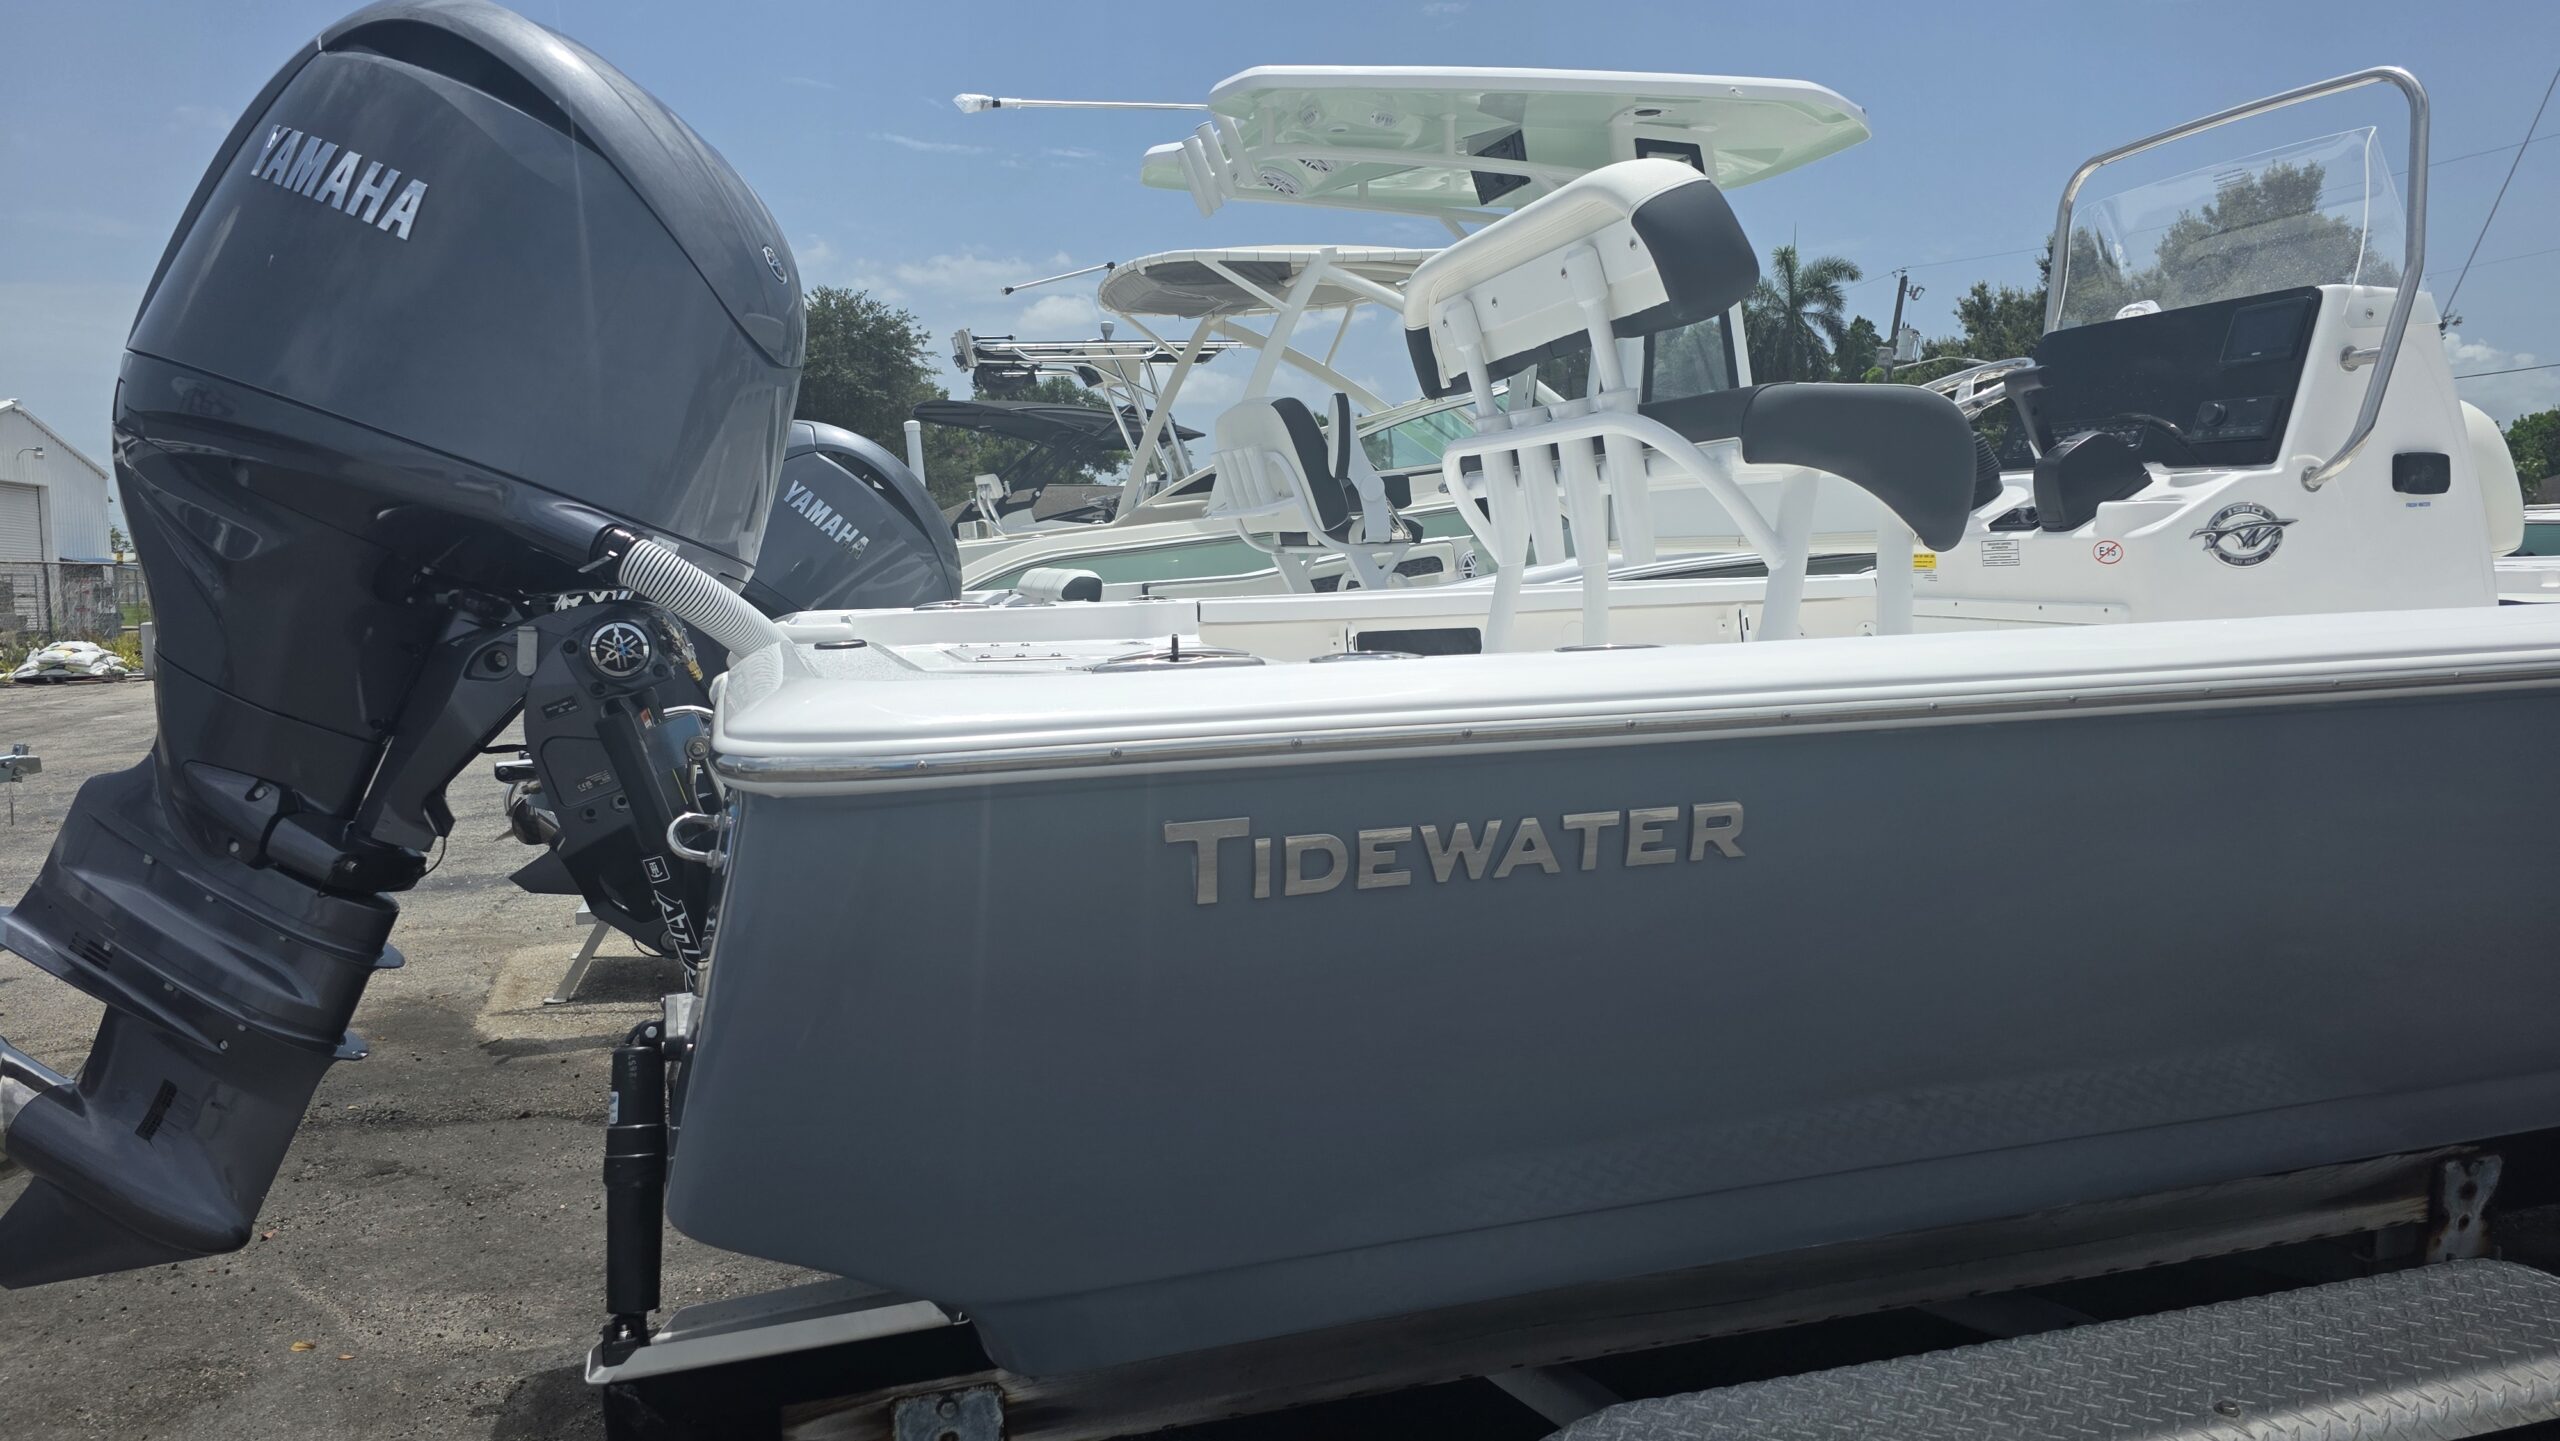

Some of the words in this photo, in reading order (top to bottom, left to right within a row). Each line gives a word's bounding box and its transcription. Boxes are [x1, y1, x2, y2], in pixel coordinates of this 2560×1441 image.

[251, 124, 428, 241] YAMAHA
[783, 479, 870, 560] YAMAHA
[2227, 506, 2264, 516] 1910
[2099, 546, 2117, 557] E15
[2244, 557, 2259, 565] MAX
[1164, 801, 1745, 905] TIDEWATER
